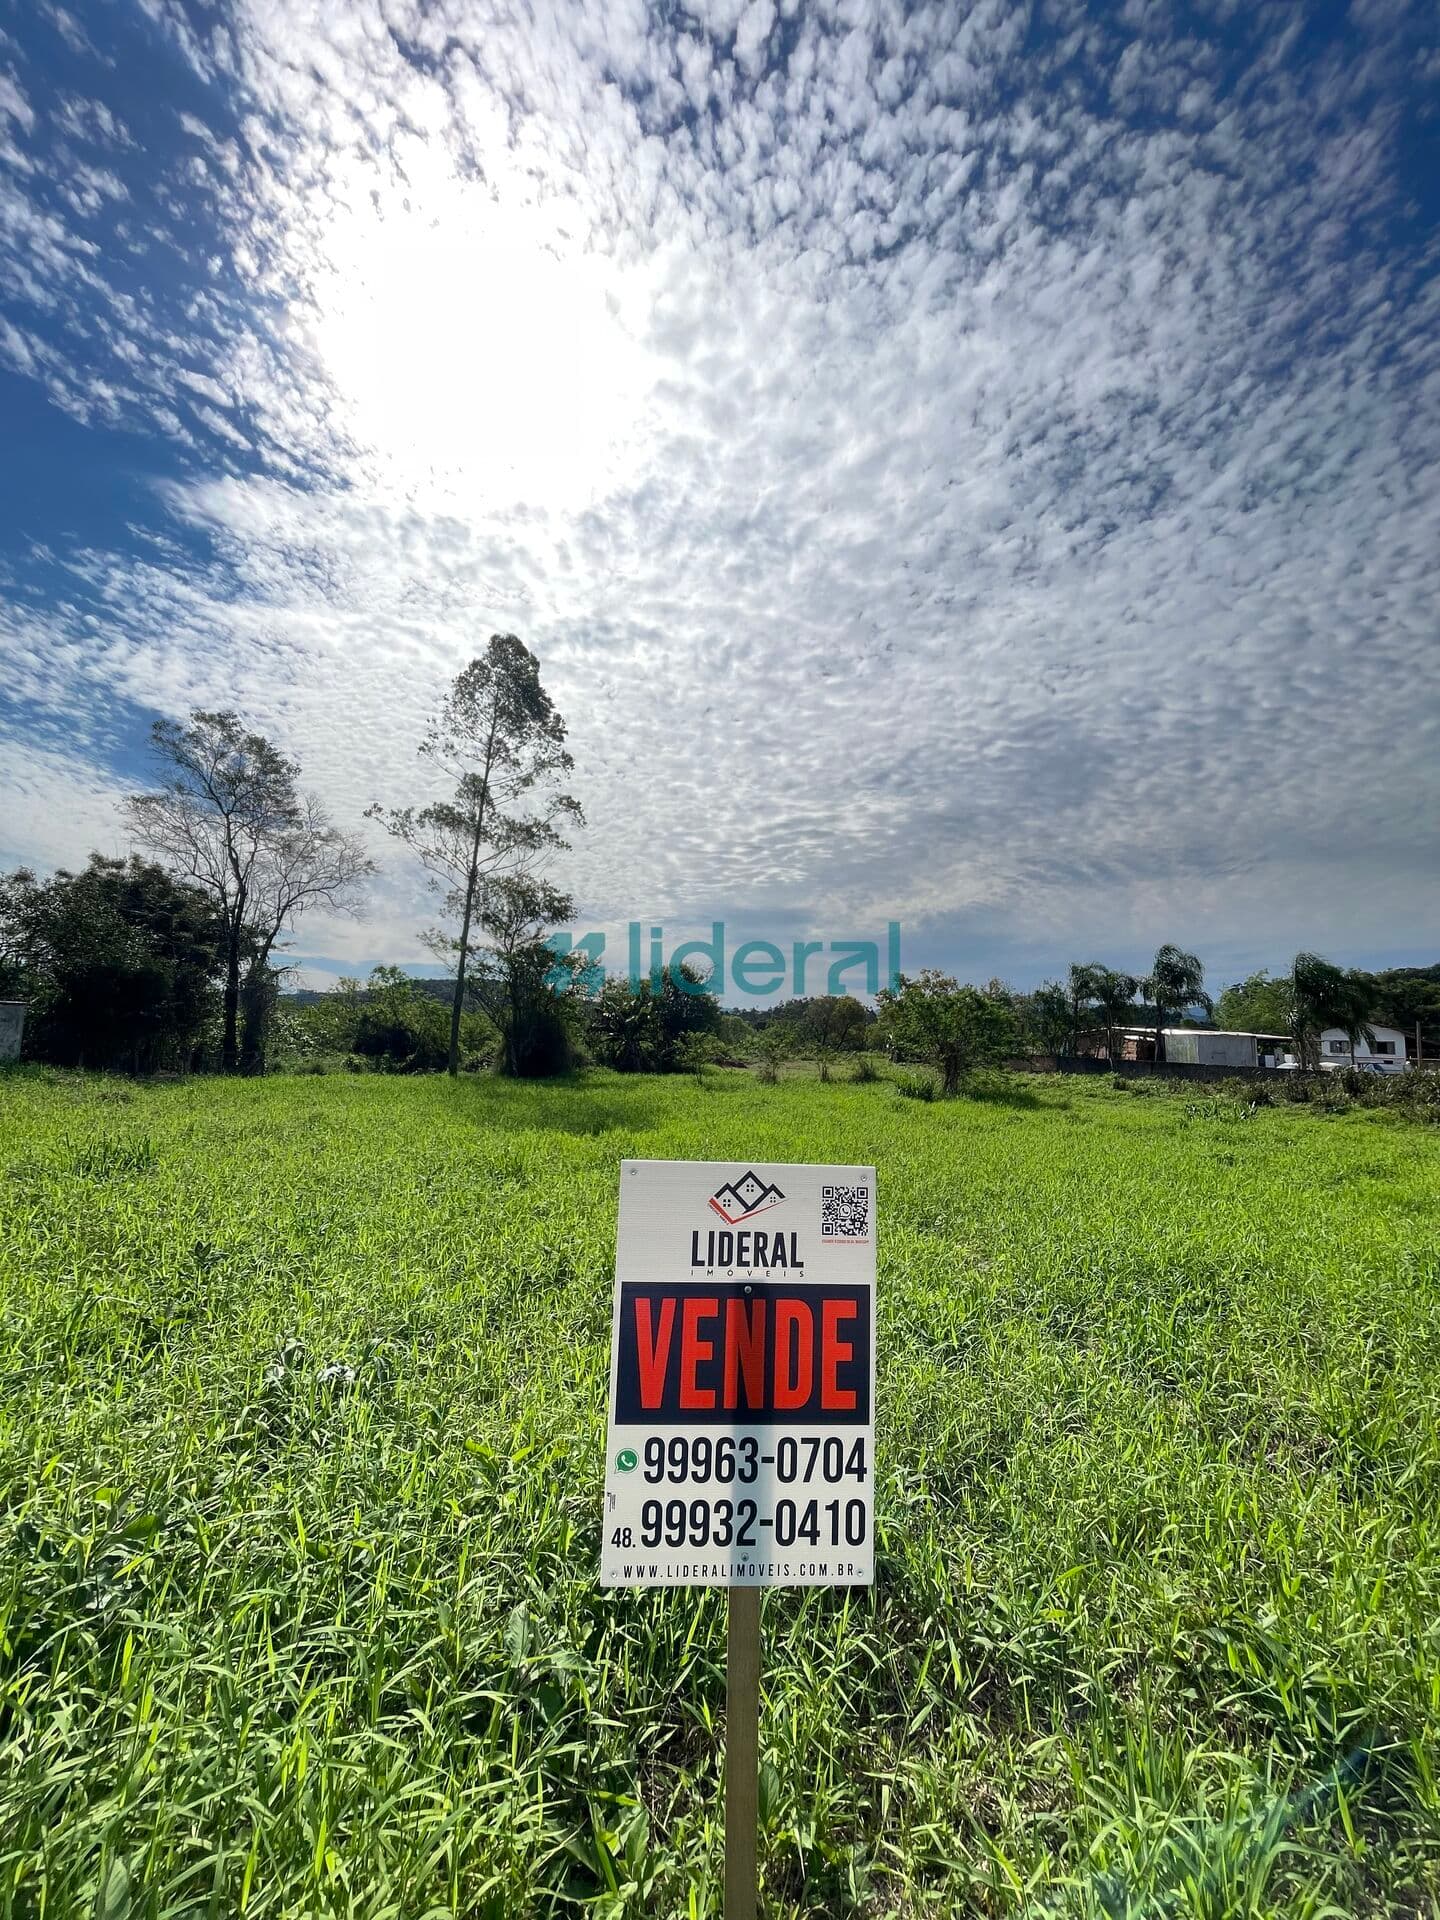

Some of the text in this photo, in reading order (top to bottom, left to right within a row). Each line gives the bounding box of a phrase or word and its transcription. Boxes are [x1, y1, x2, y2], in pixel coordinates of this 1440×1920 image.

[691, 1230, 805, 1268] LIDERAL
[634, 1297, 858, 1410] VENDE
[643, 1436, 868, 1484] 99963-0704
[623, 1563, 854, 1578] WWW.LIDERALIMOVEIS.COM.BR
